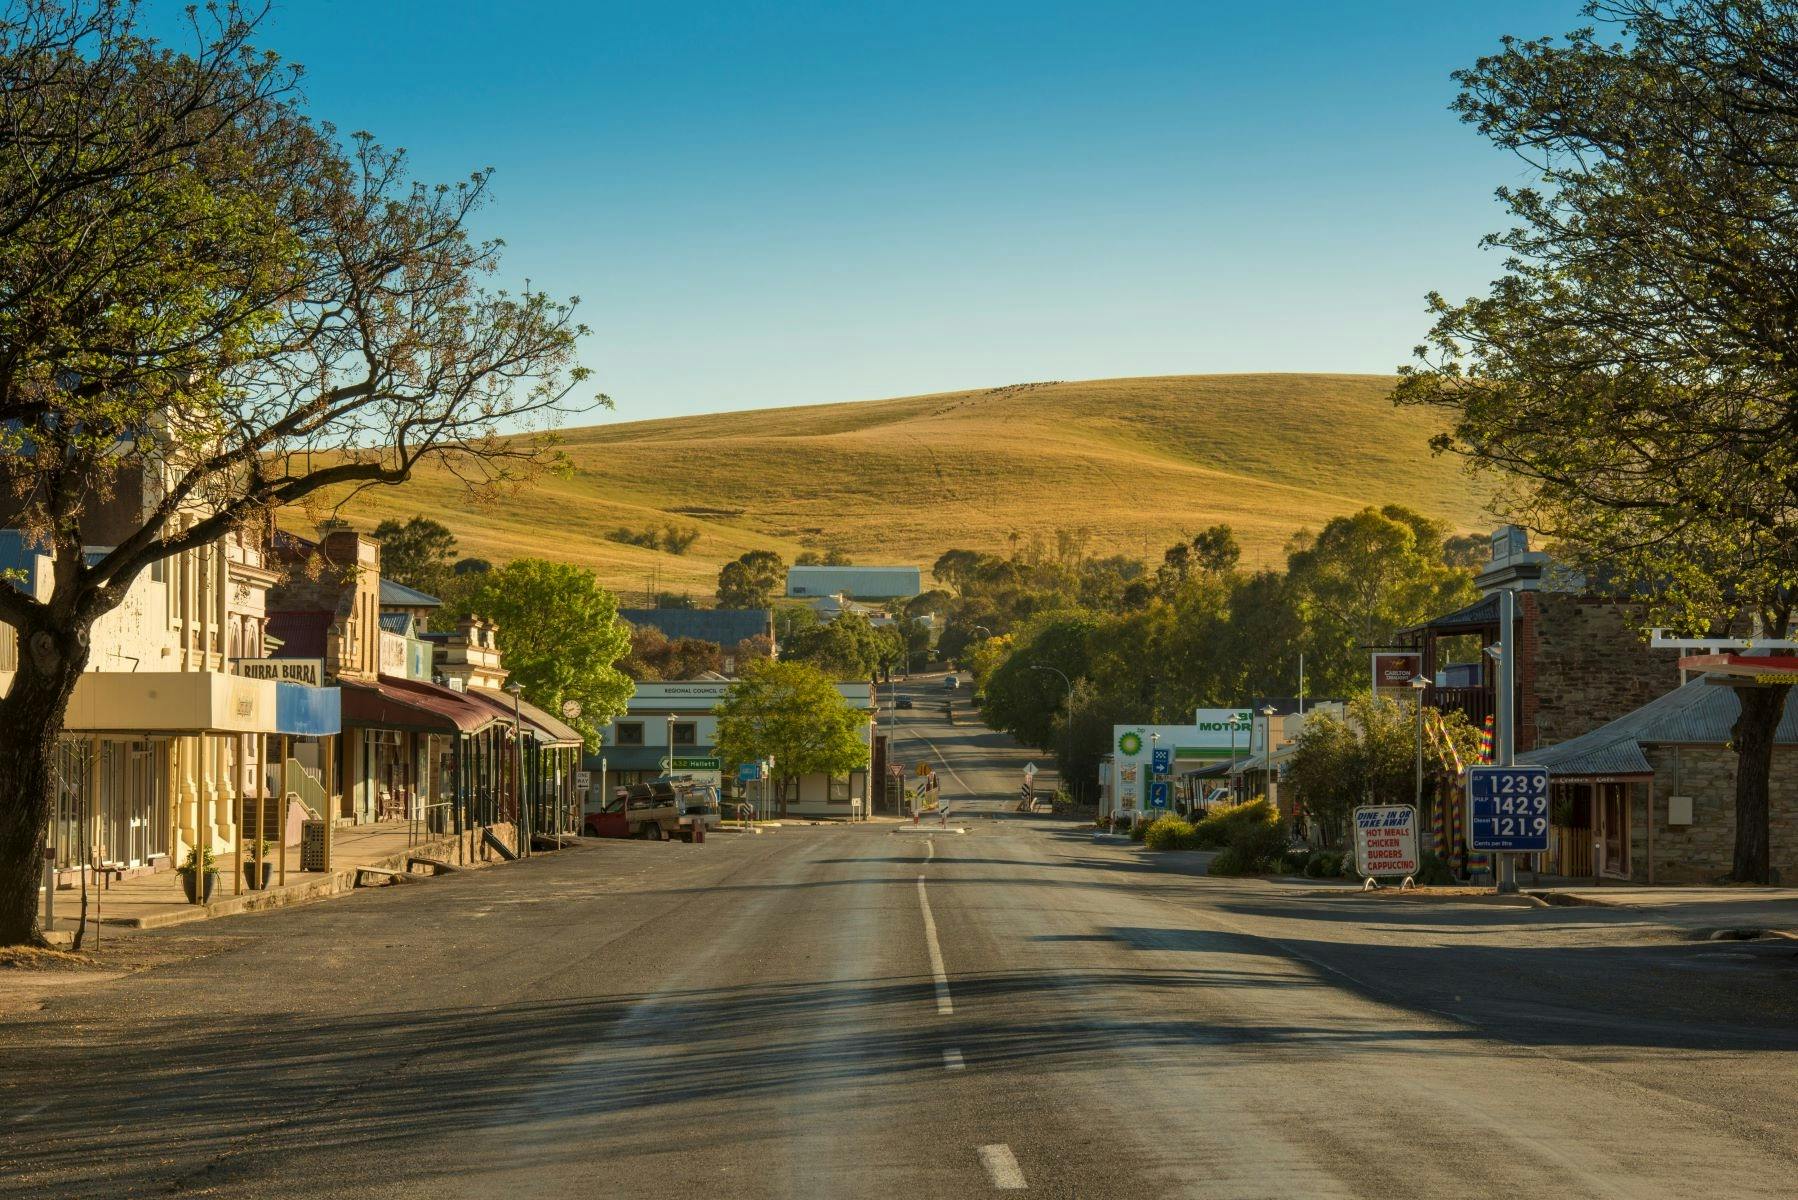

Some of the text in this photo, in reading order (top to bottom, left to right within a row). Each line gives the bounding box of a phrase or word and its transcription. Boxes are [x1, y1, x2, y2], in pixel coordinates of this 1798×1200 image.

[244, 664, 317, 686] BURRA BURRA
[1491, 775, 1546, 794] 123.9
[1494, 796, 1547, 815] 142.9
[1358, 812, 1379, 820] DINE
[1387, 811, 1397, 819] IN
[1359, 818, 1408, 828] TAKE AWAY
[1491, 817, 1546, 837] 121.9
[1366, 828, 1409, 837] HOT MEALS
[1367, 838, 1400, 848] CHICKEN
[1368, 850, 1403, 859] BURGERS
[1367, 860, 1415, 871] CAPPUCCINO
